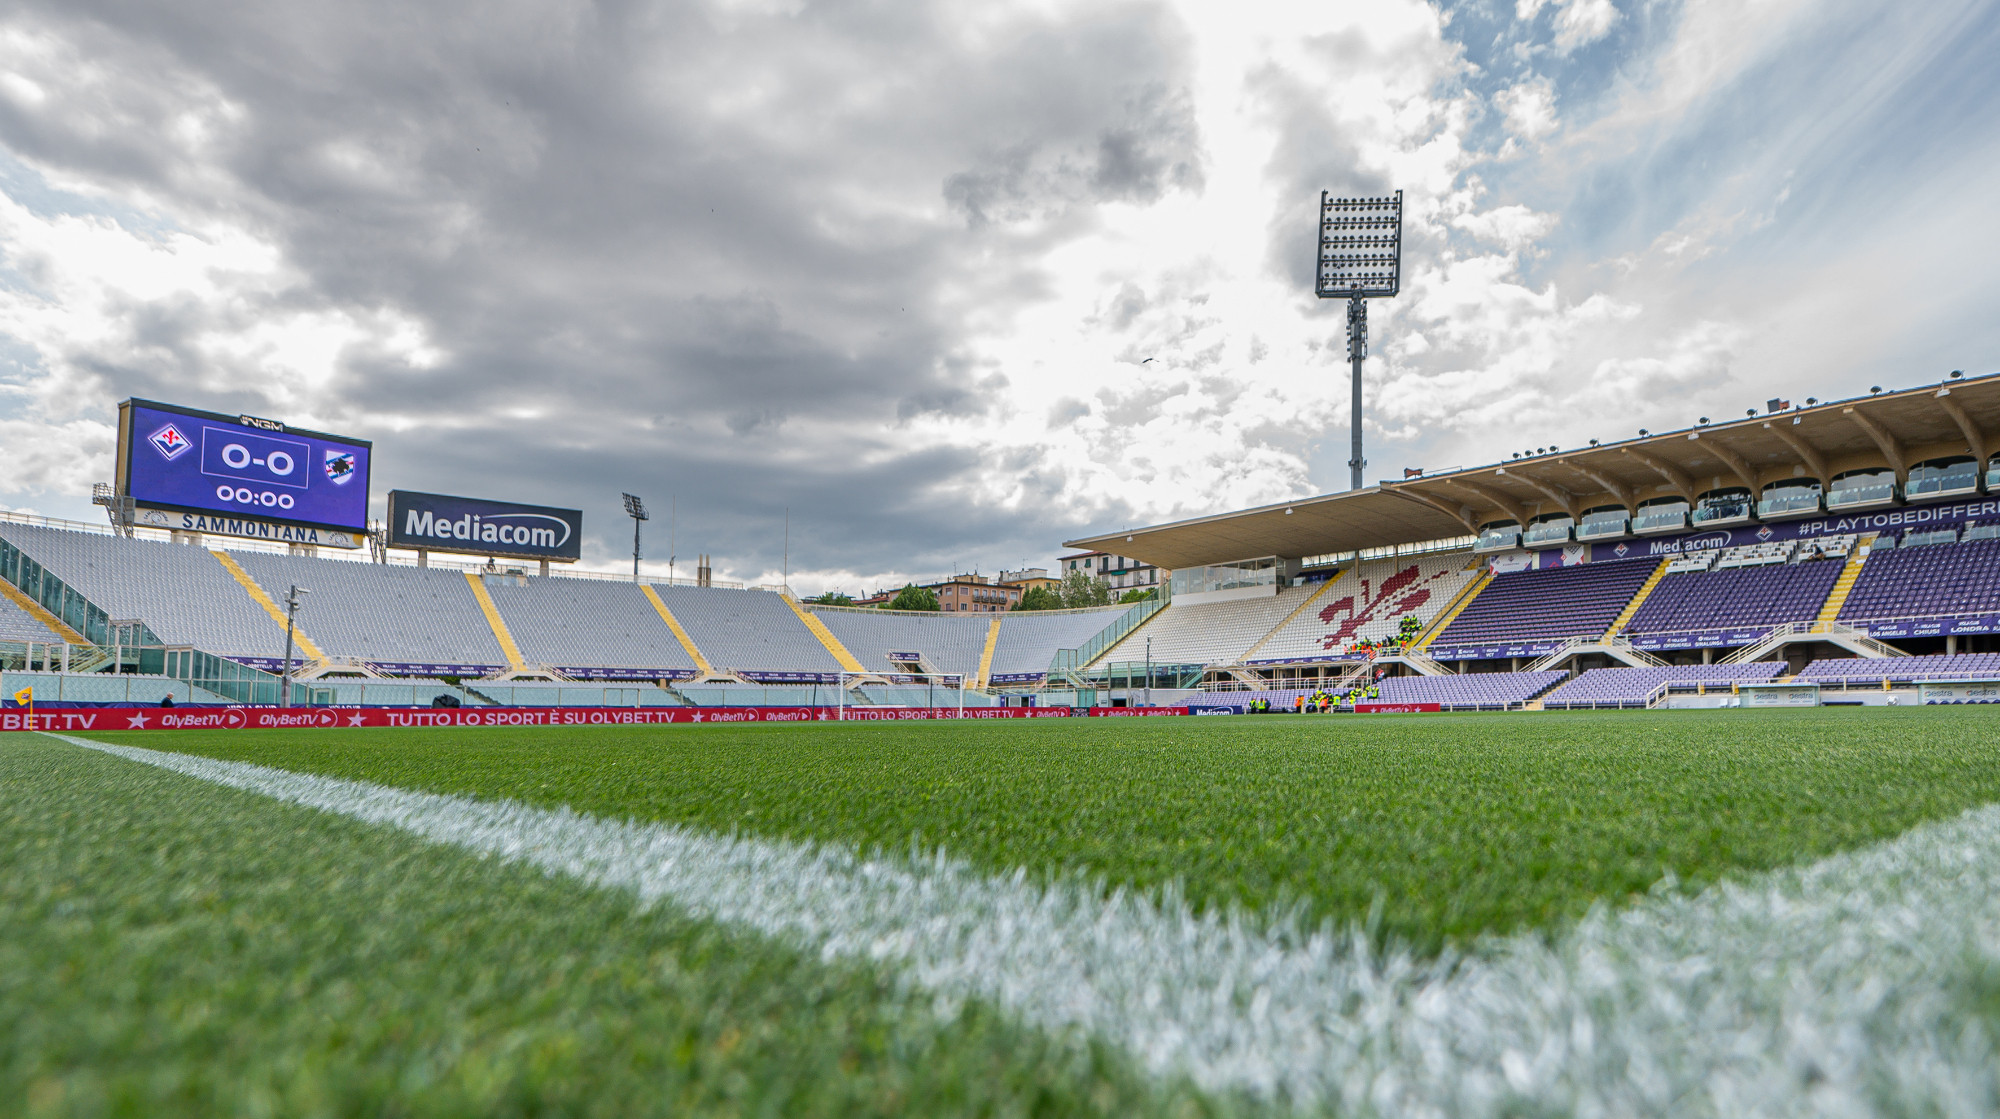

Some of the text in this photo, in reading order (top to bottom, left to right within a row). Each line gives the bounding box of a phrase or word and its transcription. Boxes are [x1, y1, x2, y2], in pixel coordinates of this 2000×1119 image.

[222, 443, 294, 476] 0-0
[216, 485, 294, 509] 00:00
[182, 513, 318, 543] SAMMONTANA
[405, 509, 555, 548] Mediacom
[1950, 625, 1990, 633] LONDRA
[161, 714, 226, 728] OlyBetTV
[259, 714, 319, 728] OlyBetTV
[386, 709, 675, 727] TUTTO LO SPORT È SU OLYBET.TV
[710, 713, 747, 722] OlyBetTV
[766, 713, 800, 722] OlyBetTV
[881, 711, 896, 720] LO
[945, 711, 960, 719] SU
[962, 710, 1015, 719] OLYBET.TV
